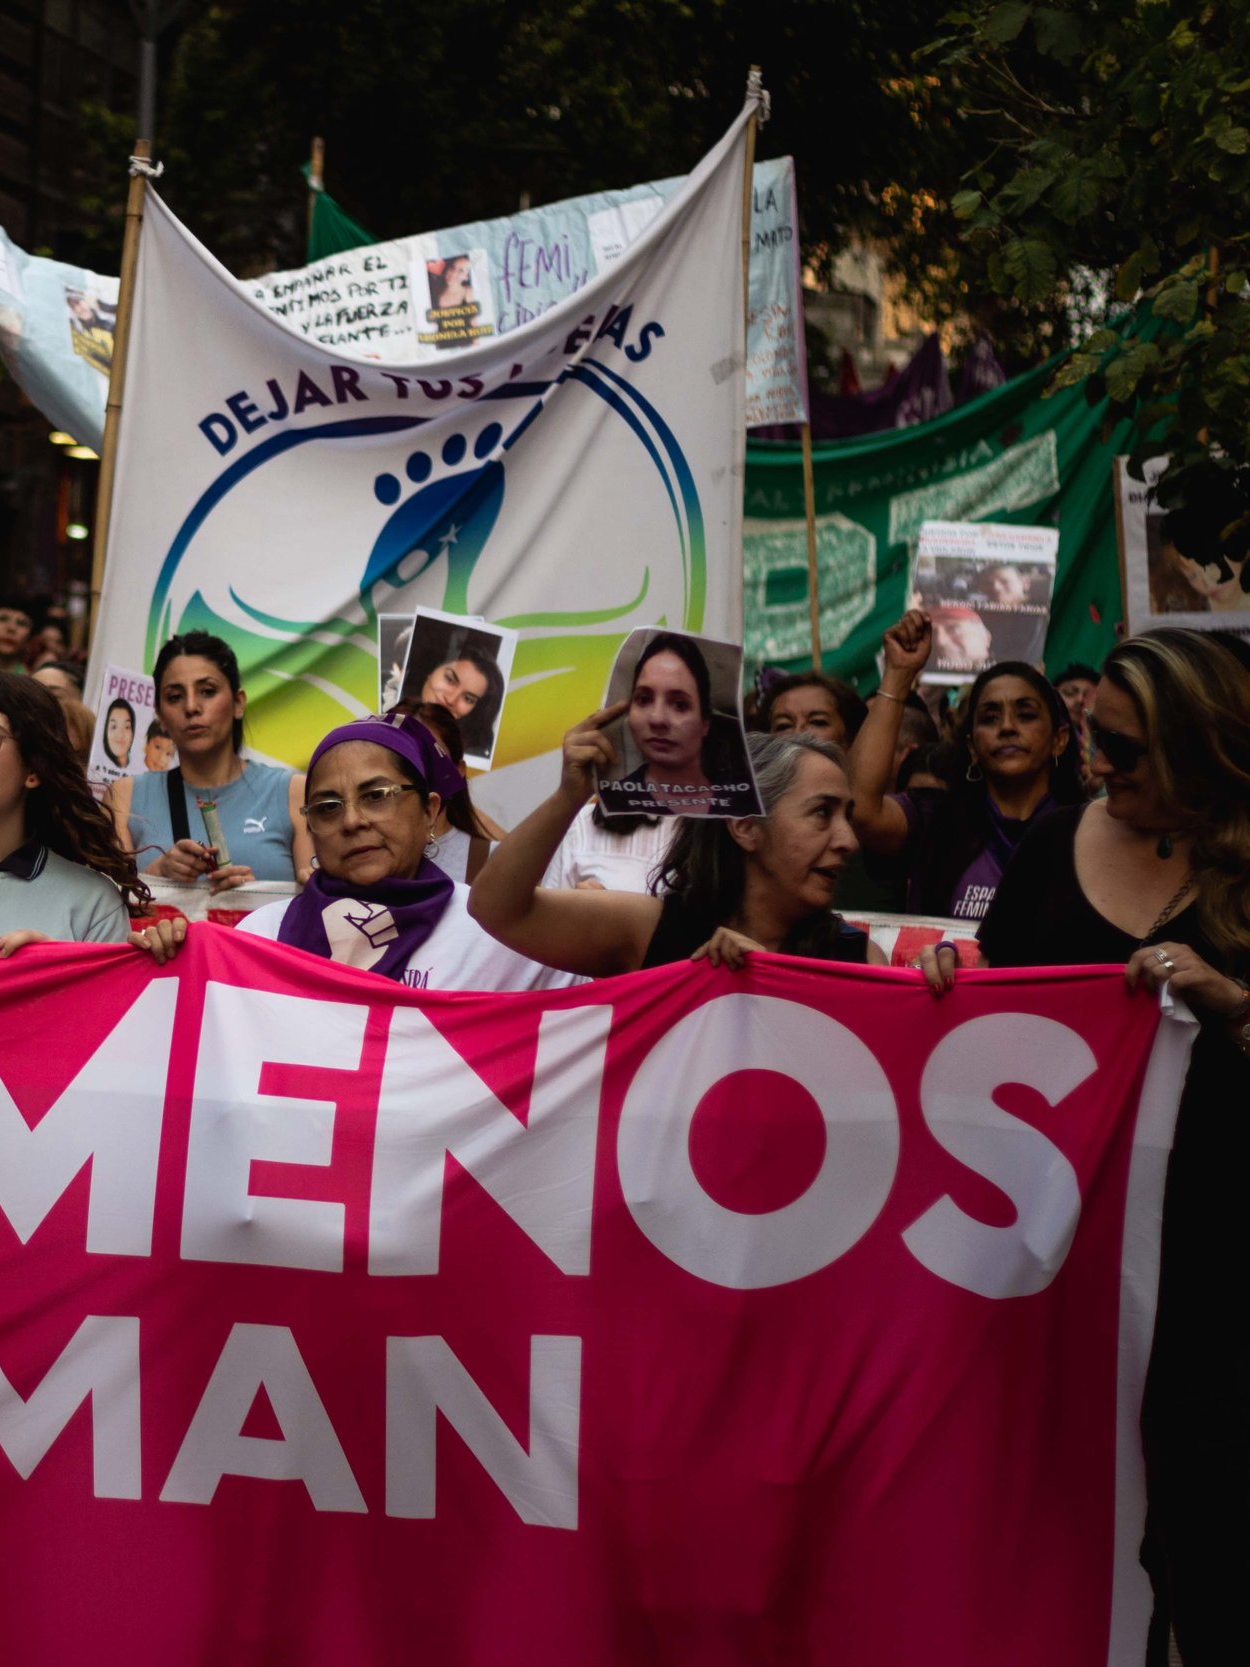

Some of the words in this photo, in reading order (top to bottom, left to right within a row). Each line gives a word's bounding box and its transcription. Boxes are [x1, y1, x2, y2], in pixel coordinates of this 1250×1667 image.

[198, 363, 362, 457] DEJAR
[108, 674, 156, 708] PRESE
[599, 780, 657, 794] PAOLA
[660, 783, 751, 794] TACACHO
[627, 797, 732, 808] PRESENTE
